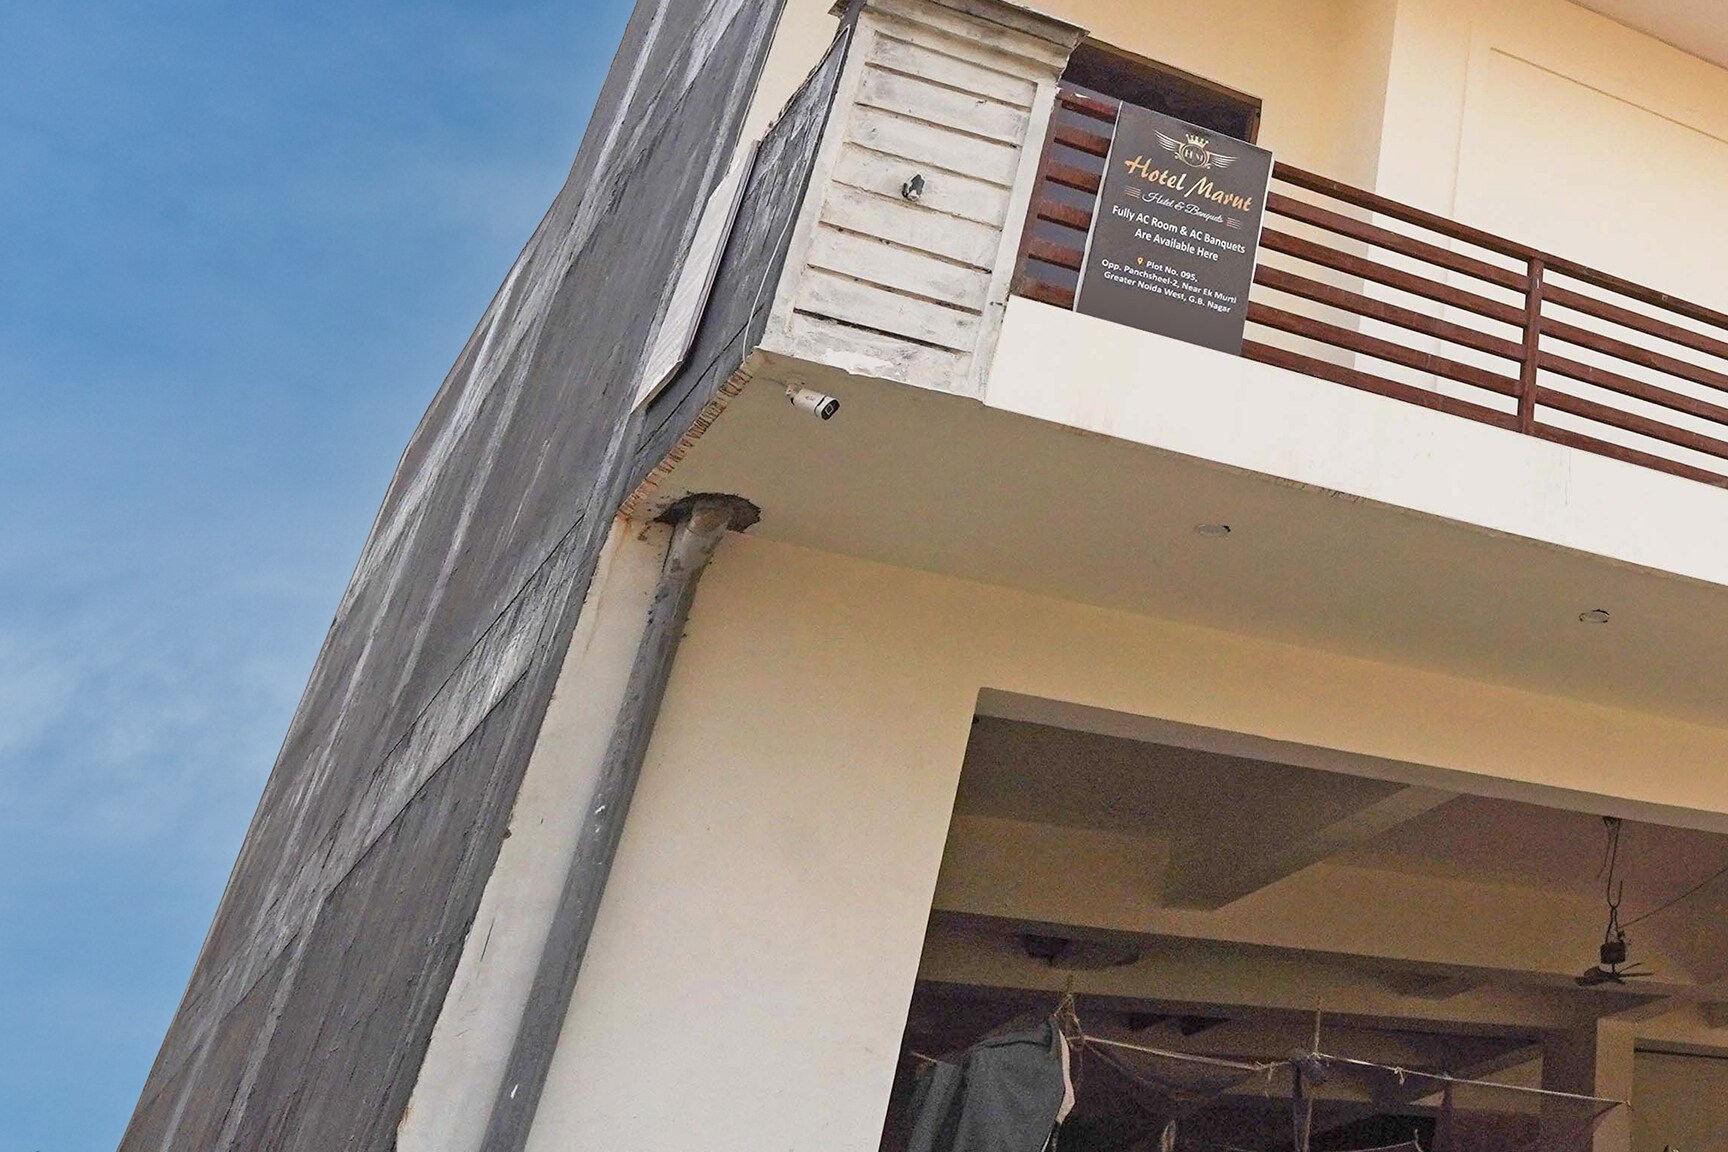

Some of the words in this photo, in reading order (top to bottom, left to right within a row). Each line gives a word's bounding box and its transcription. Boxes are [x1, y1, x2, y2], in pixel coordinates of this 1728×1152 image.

[1124, 155, 1187, 191] Hotel
[1184, 176, 1253, 212] Marut
[1112, 205, 1135, 222] Fully
[1136, 213, 1149, 225] AC
[1151, 217, 1178, 233] Room
[1180, 226, 1188, 236] &
[1189, 229, 1203, 241] AC
[1204, 233, 1246, 254] Banquets
[1134, 228, 1152, 241] Are
[1153, 234, 1196, 254] Available
[1196, 246, 1219, 261] Here
[1101, 259, 1122, 271] Opp.
[1182, 282, 1202, 294] Near
[1203, 288, 1213, 297] Ek
[1146, 260, 1163, 272] Plot
[1164, 266, 1179, 276] No.
[1103, 271, 1136, 286] Greater
[1137, 280, 1162, 294] Noida
[1164, 287, 1187, 302] West,
[1188, 295, 1206, 306] G.B.
[1207, 301, 1231, 314] Nagar
